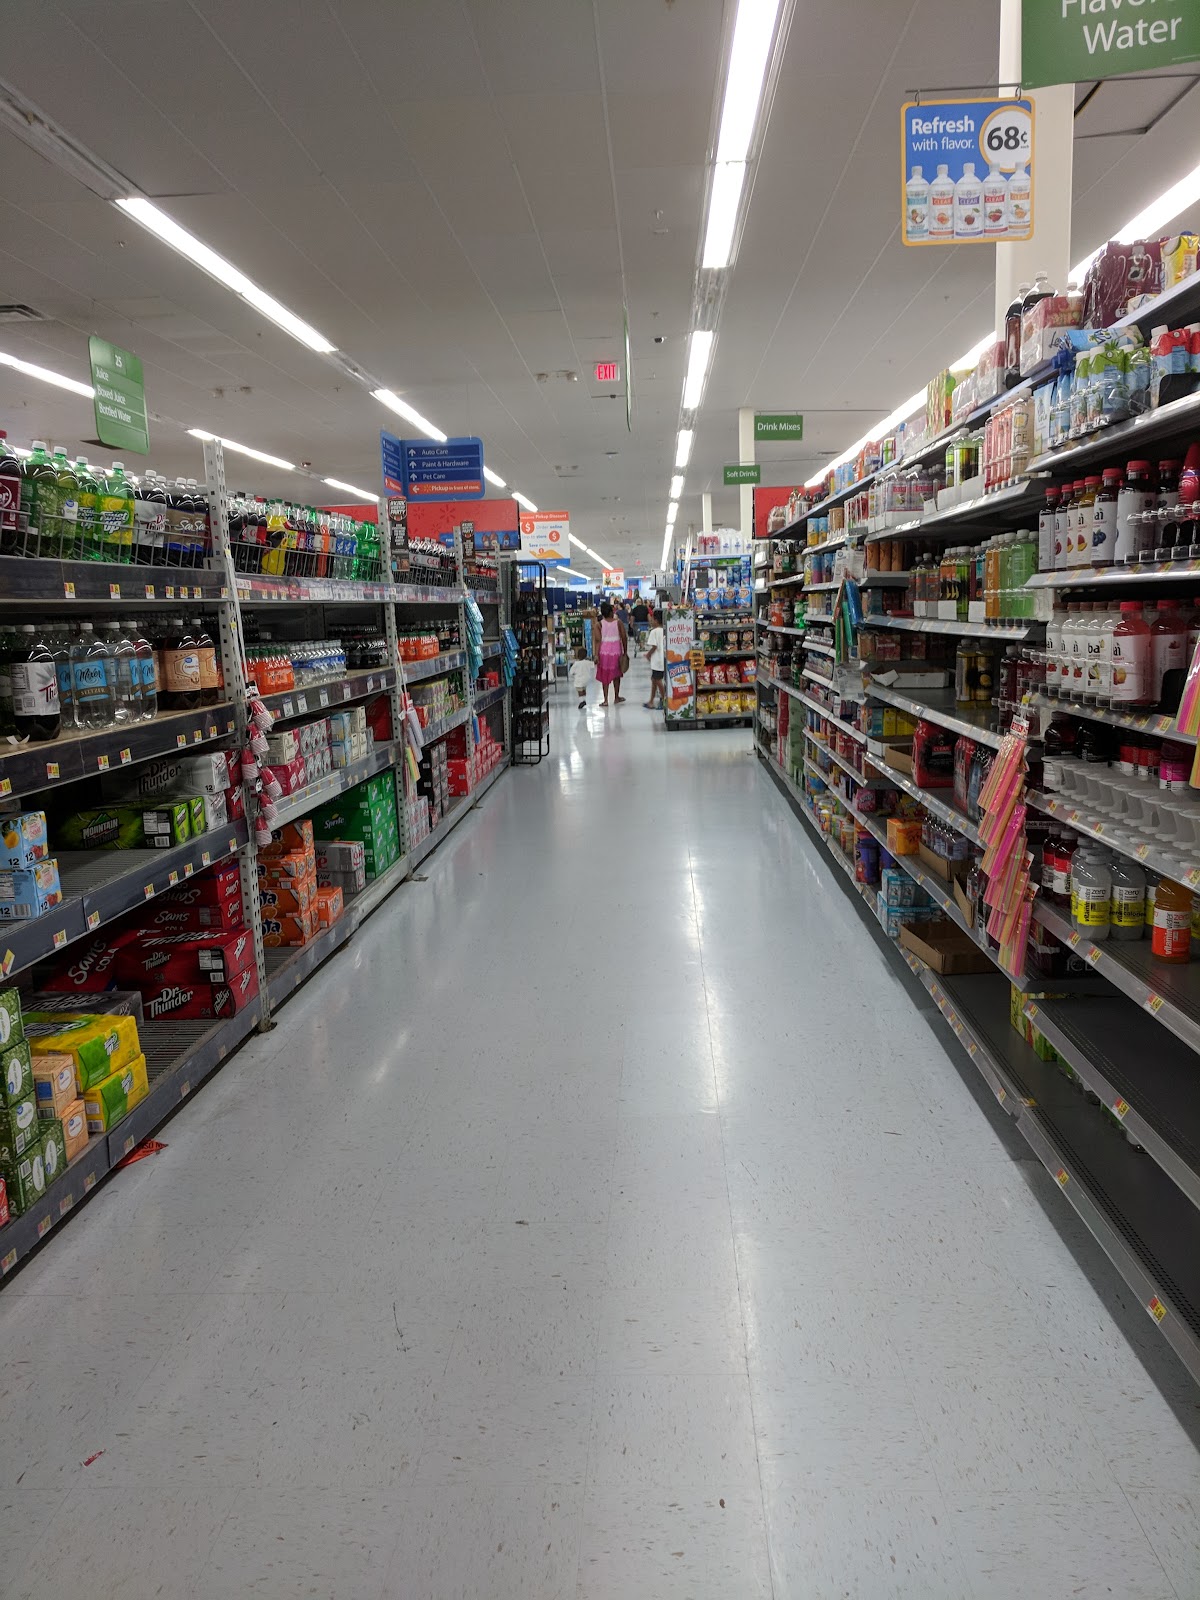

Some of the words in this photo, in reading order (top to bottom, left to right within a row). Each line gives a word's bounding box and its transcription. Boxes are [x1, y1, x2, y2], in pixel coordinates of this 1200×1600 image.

[1082, 17, 1182, 55] Water
[911, 115, 975, 135] Refresh
[912, 138, 939, 151] with
[941, 135, 975, 151] flavor.
[96, 366, 109, 382] Juice
[597, 364, 616, 380] EXIT
[97, 384, 114, 401] Boxed
[114, 392, 126, 405] Juice
[98, 401, 118, 418] Bottled
[117, 408, 131, 423] Water
[757, 422, 778, 432] Drink
[779, 422, 801, 432] Mixes
[726, 470, 738, 478] Soft
[739, 469, 758, 478] Drinks
[432, 484, 448, 492] Pickup
[76, 668, 103, 683] Mixer
[80, 687, 106, 697] SELTZER
[130, 765, 182, 796] Thunder
[205, 784, 213, 792] 12
[83, 817, 119, 838] MOUNTAIN
[324, 816, 345, 830] Sprite
[8, 857, 19, 866] 12
[25, 851, 35, 862] 12
[1091, 888, 1106, 896] zero
[40, 900, 49, 911] 12
[95, 947, 120, 972] COLA
[141, 952, 172, 974] Thunder
[143, 989, 195, 1019] Thunder
[200, 1007, 211, 1016] 24
